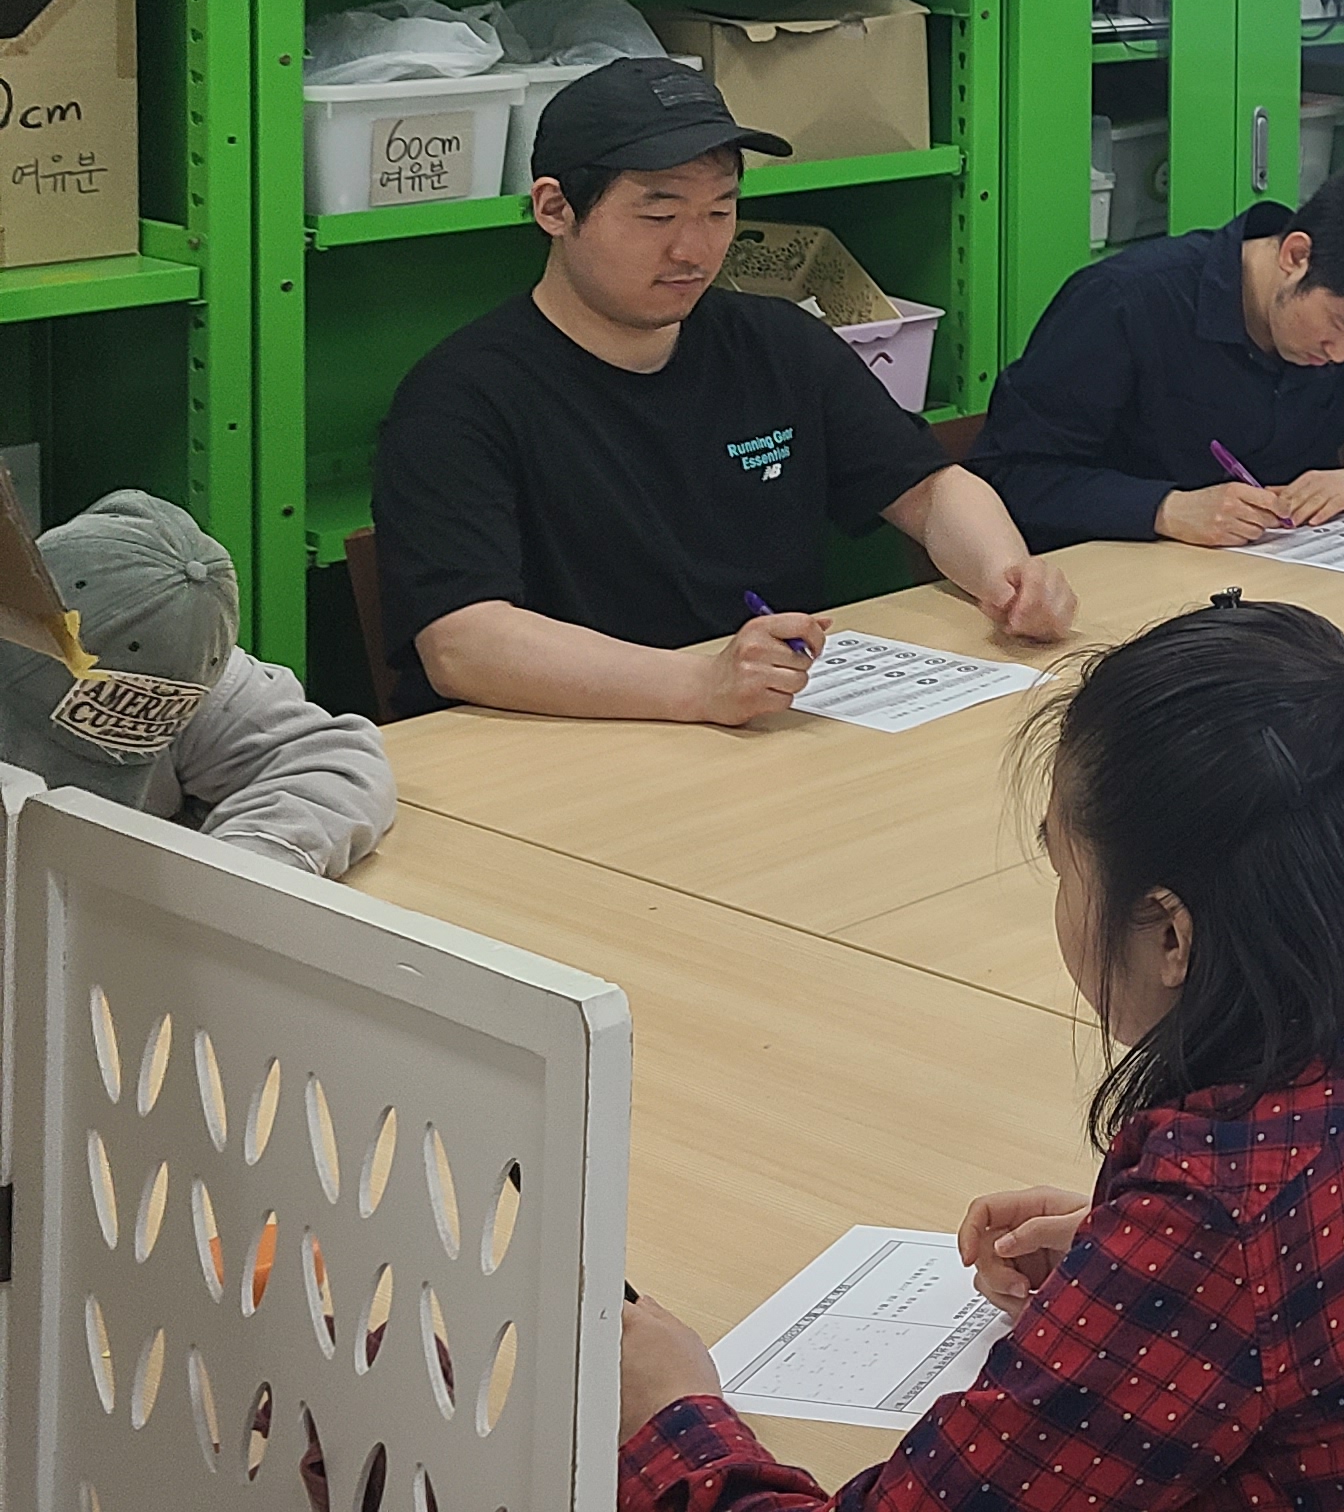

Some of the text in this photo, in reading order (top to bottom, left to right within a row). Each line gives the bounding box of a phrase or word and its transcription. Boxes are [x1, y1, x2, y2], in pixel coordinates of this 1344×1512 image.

[12, 151, 108, 195] 여유분
[380, 158, 448, 194] 여유분
[727, 436, 774, 457] Running
[742, 445, 791, 470] Essentials
